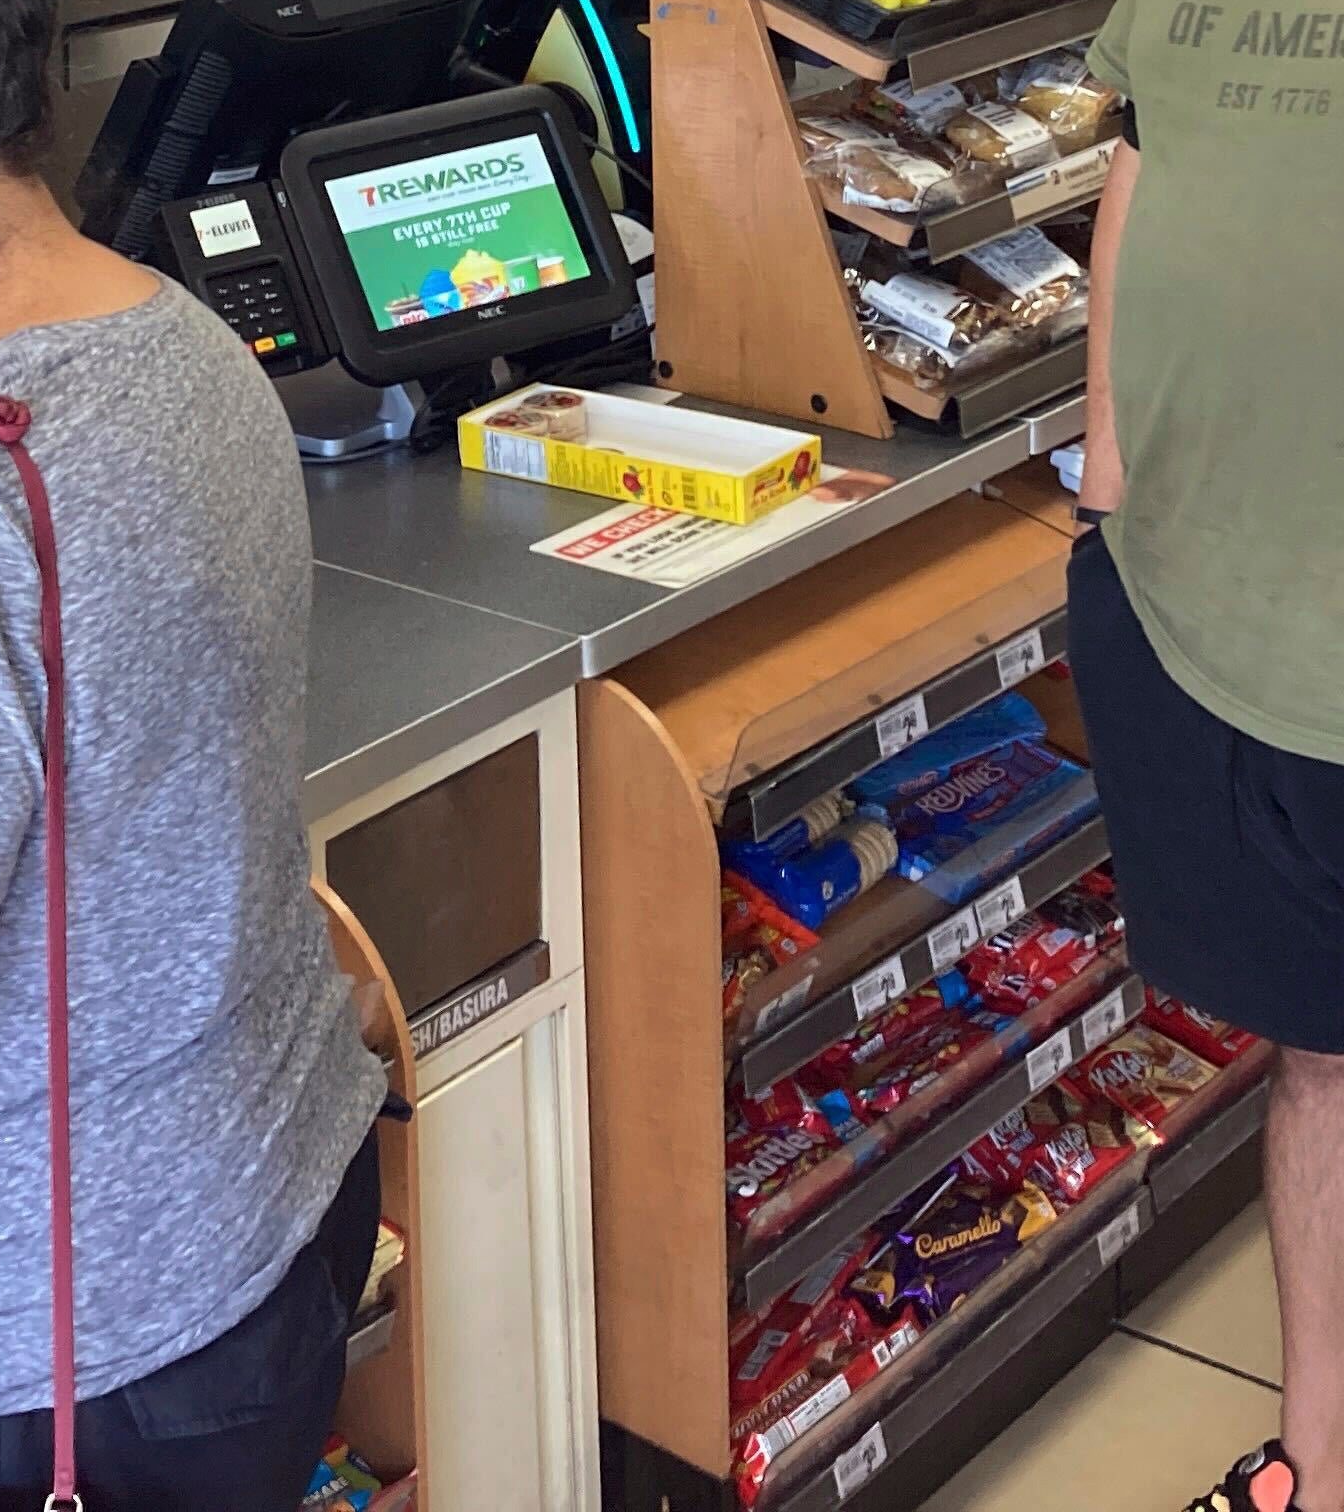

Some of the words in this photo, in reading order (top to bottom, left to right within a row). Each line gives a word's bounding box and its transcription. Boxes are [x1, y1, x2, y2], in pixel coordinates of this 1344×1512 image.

[1168, 1, 1224, 48] OF
[1215, 81, 1258, 111] EST
[1270, 87, 1331, 117] 1776
[392, 218, 443, 242] EVERY
[446, 210, 477, 231] 7TH
[479, 200, 511, 223] CUP
[415, 237, 429, 249] IS
[431, 226, 467, 246] STILL
[469, 219, 499, 237] FREE
[477, 304, 505, 320] NEC
[559, 534, 602, 557] WE
[915, 1214, 1001, 1258] Caramello
